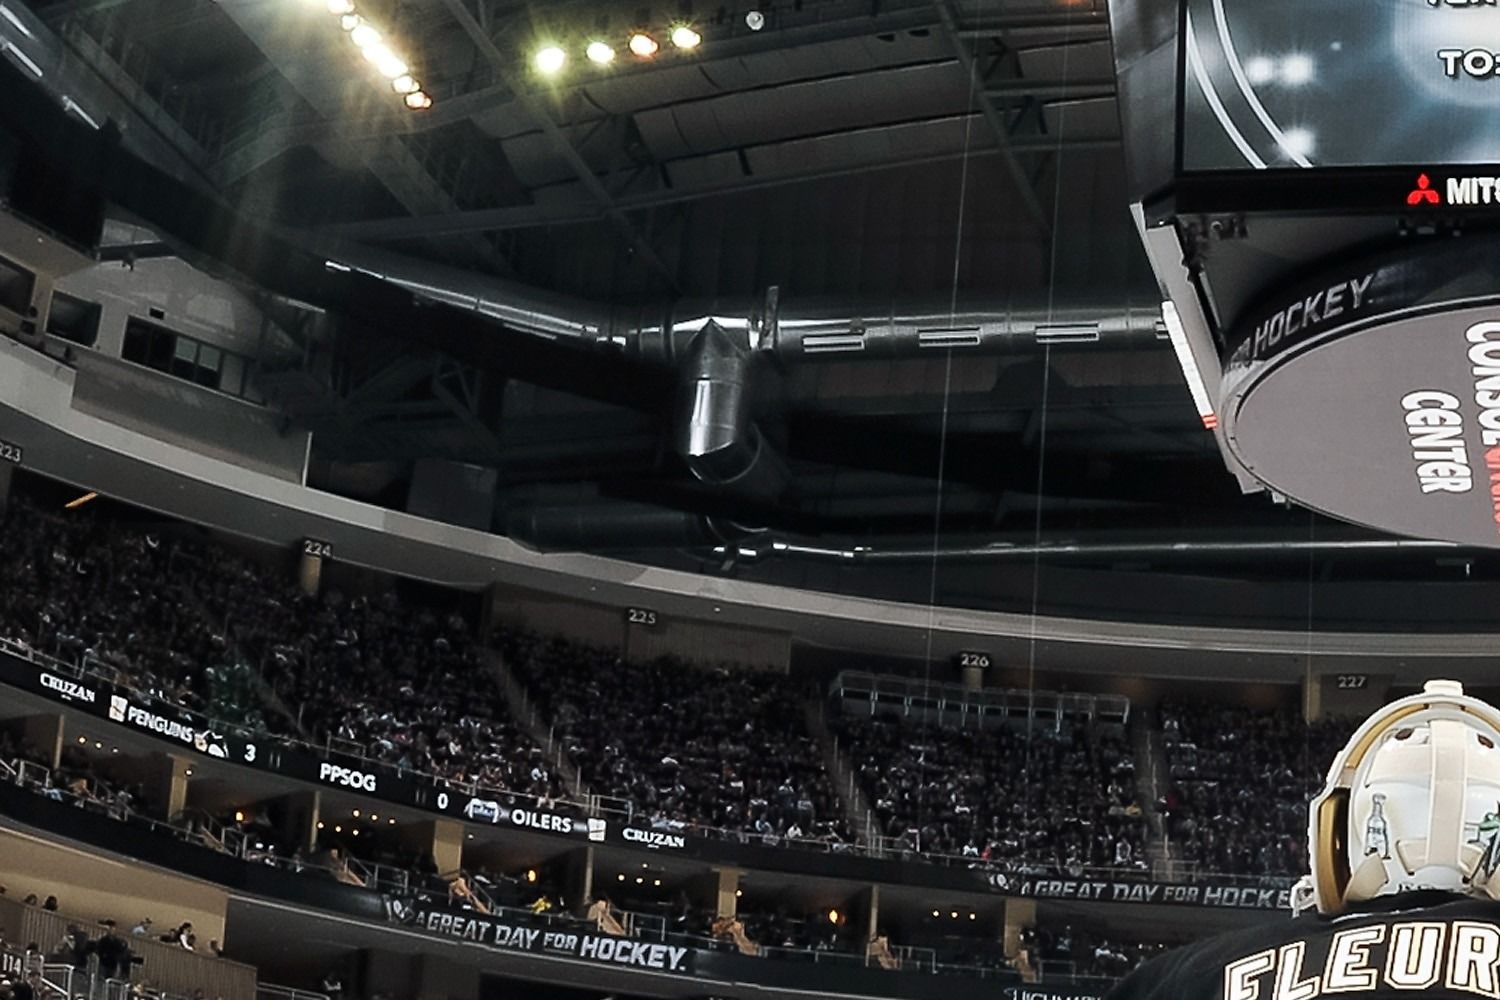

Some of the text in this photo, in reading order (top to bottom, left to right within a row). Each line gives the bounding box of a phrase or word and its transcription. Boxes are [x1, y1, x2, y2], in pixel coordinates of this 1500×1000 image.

[1400, 390, 1473, 493] CENTER
[304, 541, 332, 556] 224
[629, 610, 656, 624] 225
[961, 653, 989, 668] 226
[40, 672, 95, 702] CRUZAN
[1337, 676, 1366, 688] 227
[128, 705, 256, 762] PENGUINS 3
[320, 763, 376, 792] PPSOG
[437, 793, 572, 833] 0 OILERS
[623, 827, 685, 848] CRUZAN
[1034, 880, 1106, 899] GREAT
[1113, 884, 1158, 902] DAY
[1163, 886, 1199, 902] FOR
[1203, 887, 1292, 909] HOCKE
[427, 912, 490, 943] GREAT
[495, 924, 540, 950] DAY
[543, 931, 578, 951] FOR
